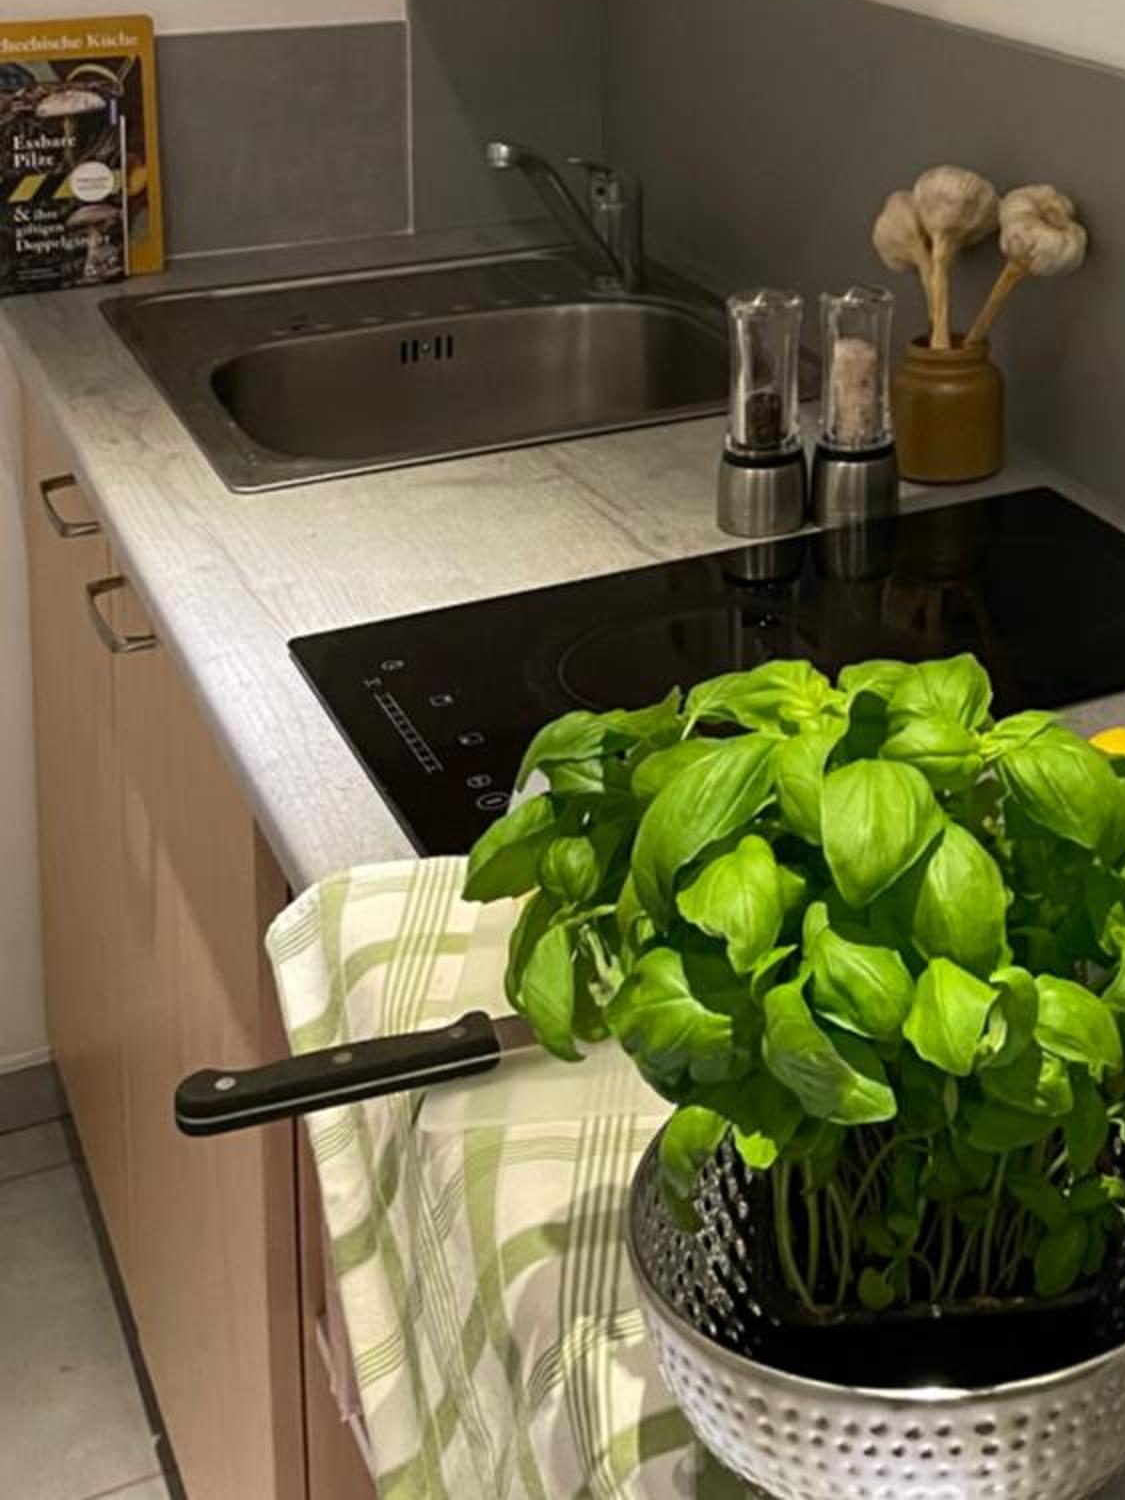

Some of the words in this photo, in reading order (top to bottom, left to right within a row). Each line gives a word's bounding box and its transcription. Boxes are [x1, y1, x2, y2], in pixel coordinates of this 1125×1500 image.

[13, 134, 77, 151] Essbare
[14, 152, 55, 168] Pilze
[13, 206, 30, 222] &
